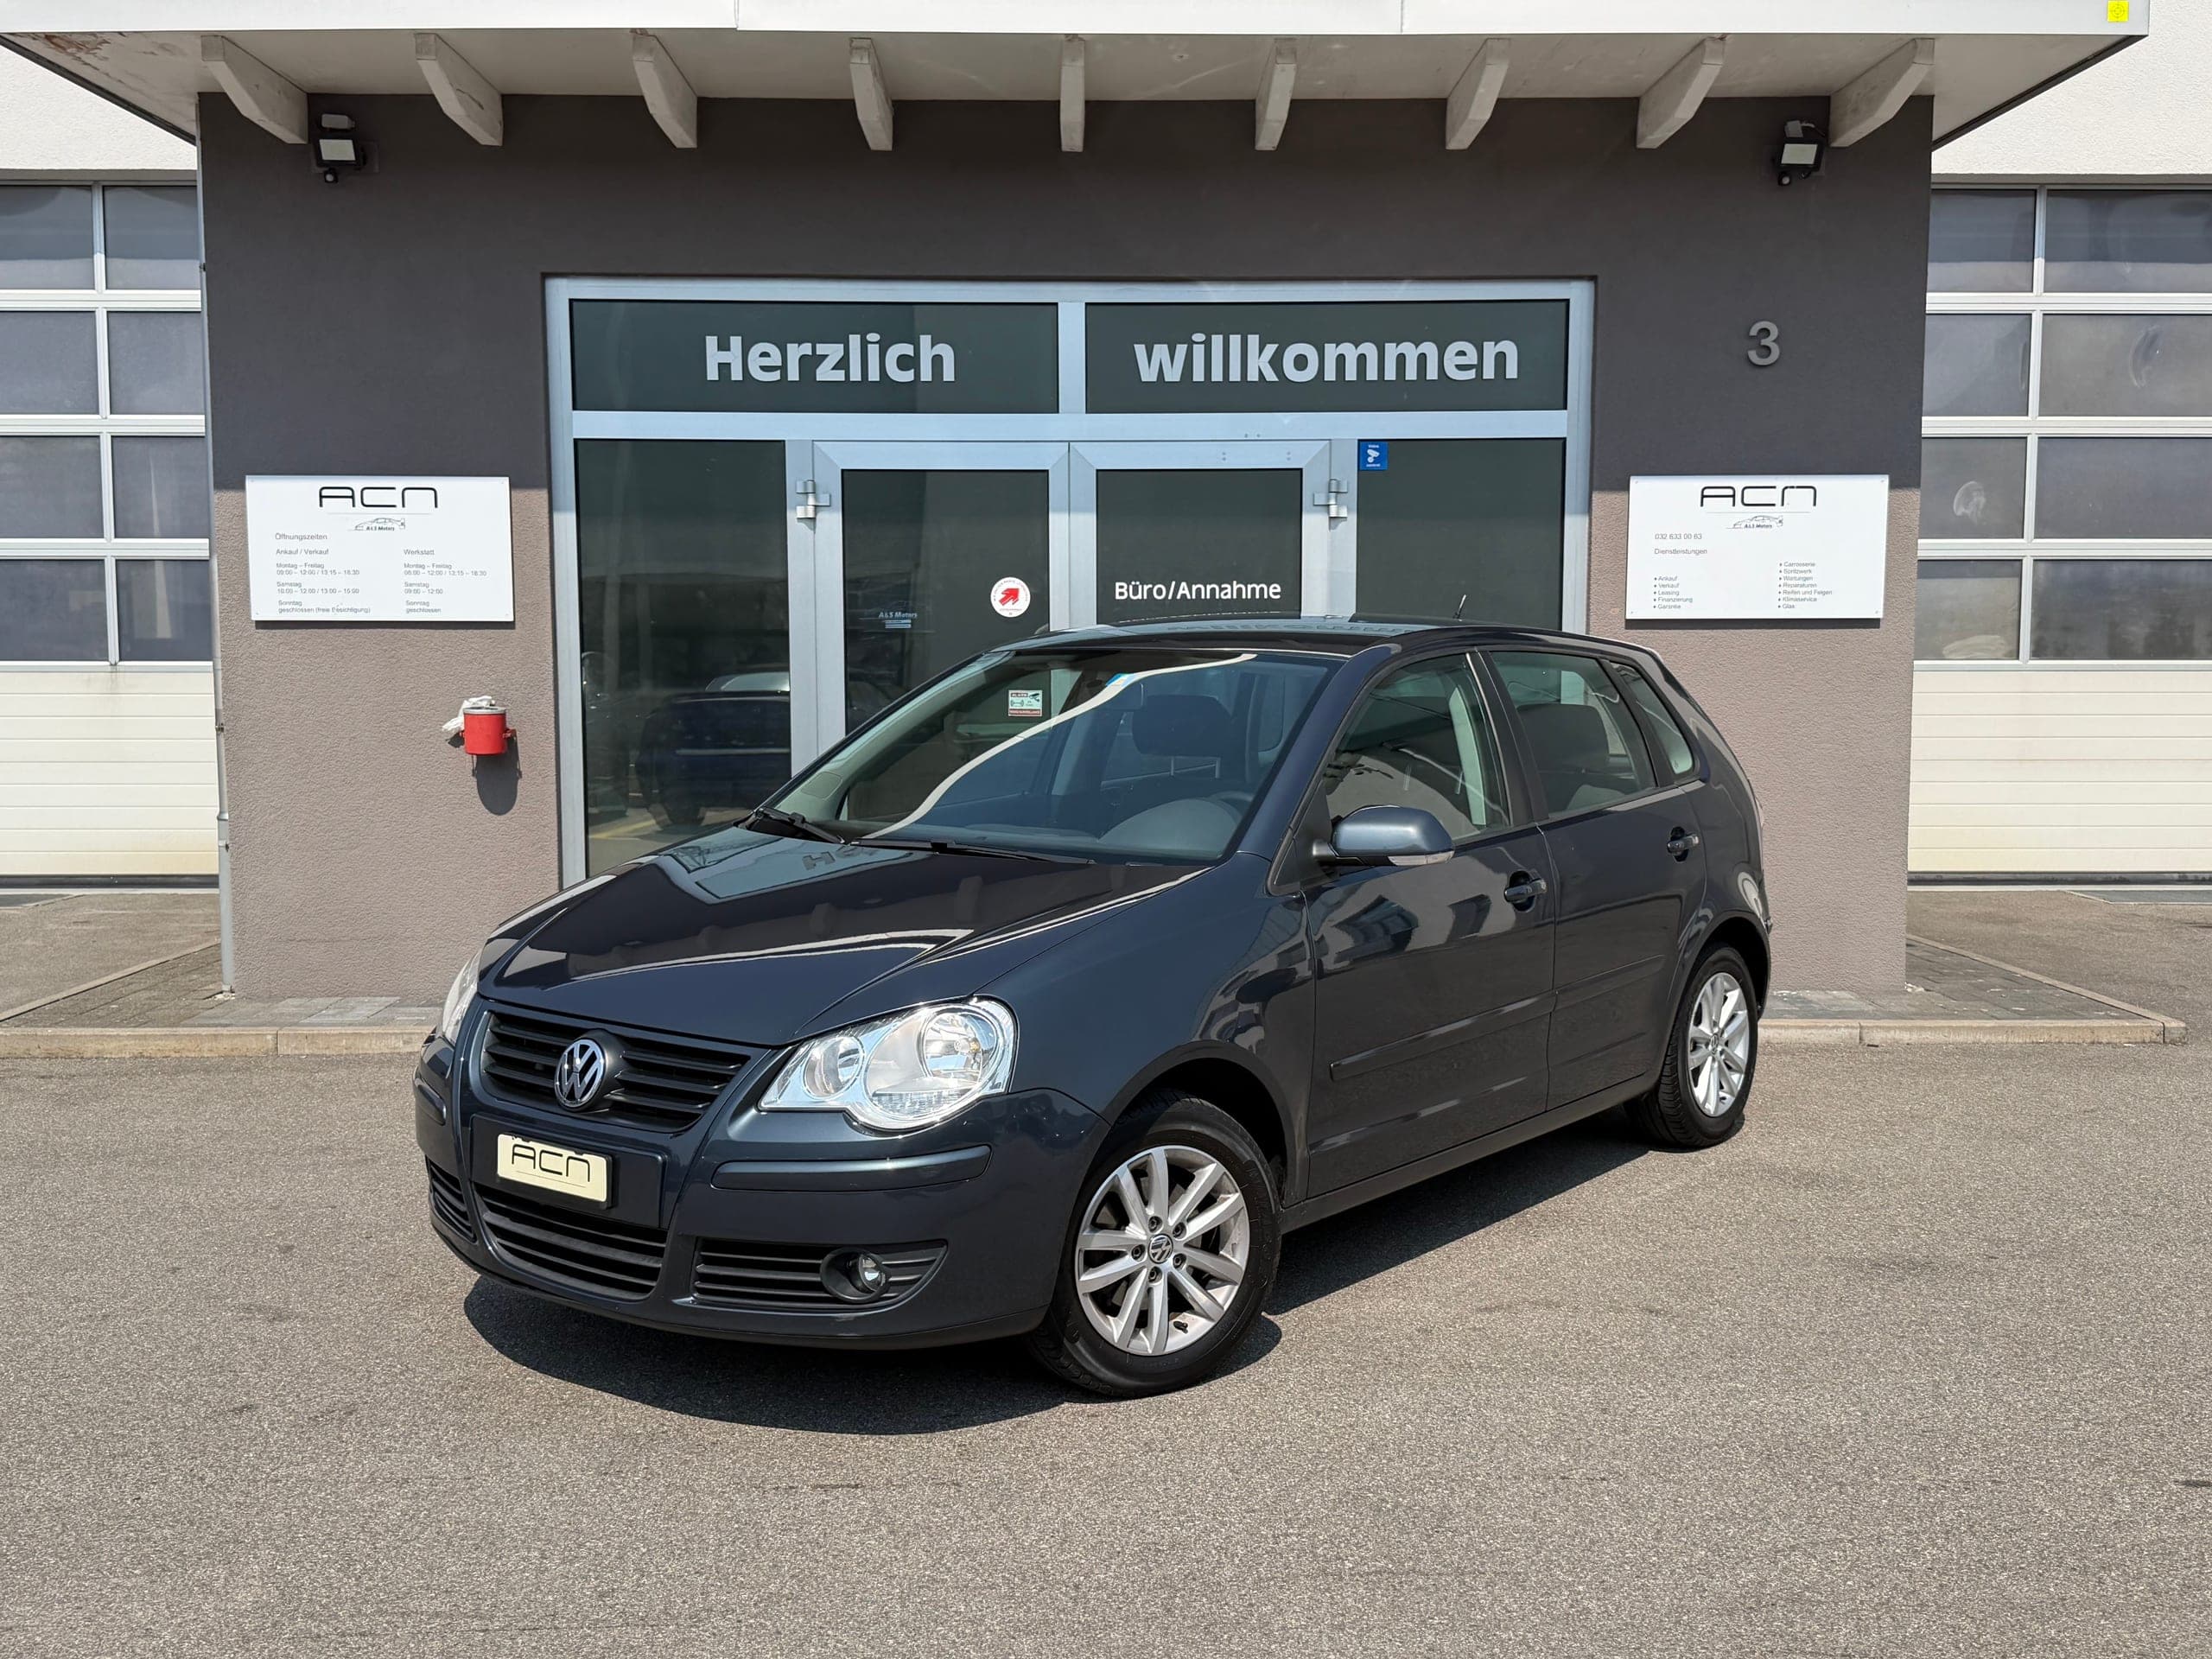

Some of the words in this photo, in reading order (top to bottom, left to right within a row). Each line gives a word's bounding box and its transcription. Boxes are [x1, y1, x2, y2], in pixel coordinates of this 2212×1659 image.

[705, 332, 956, 383] Herzlich
[1133, 333, 1519, 382] willkommen
[1747, 321, 1780, 366] 3
[319, 486, 438, 508] ACN
[1700, 486, 1817, 507] ACN
[275, 532, 327, 541] Öffnungszeiten
[1115, 581, 1281, 600] Büro/Annahme
[512, 1144, 590, 1182] ACN
